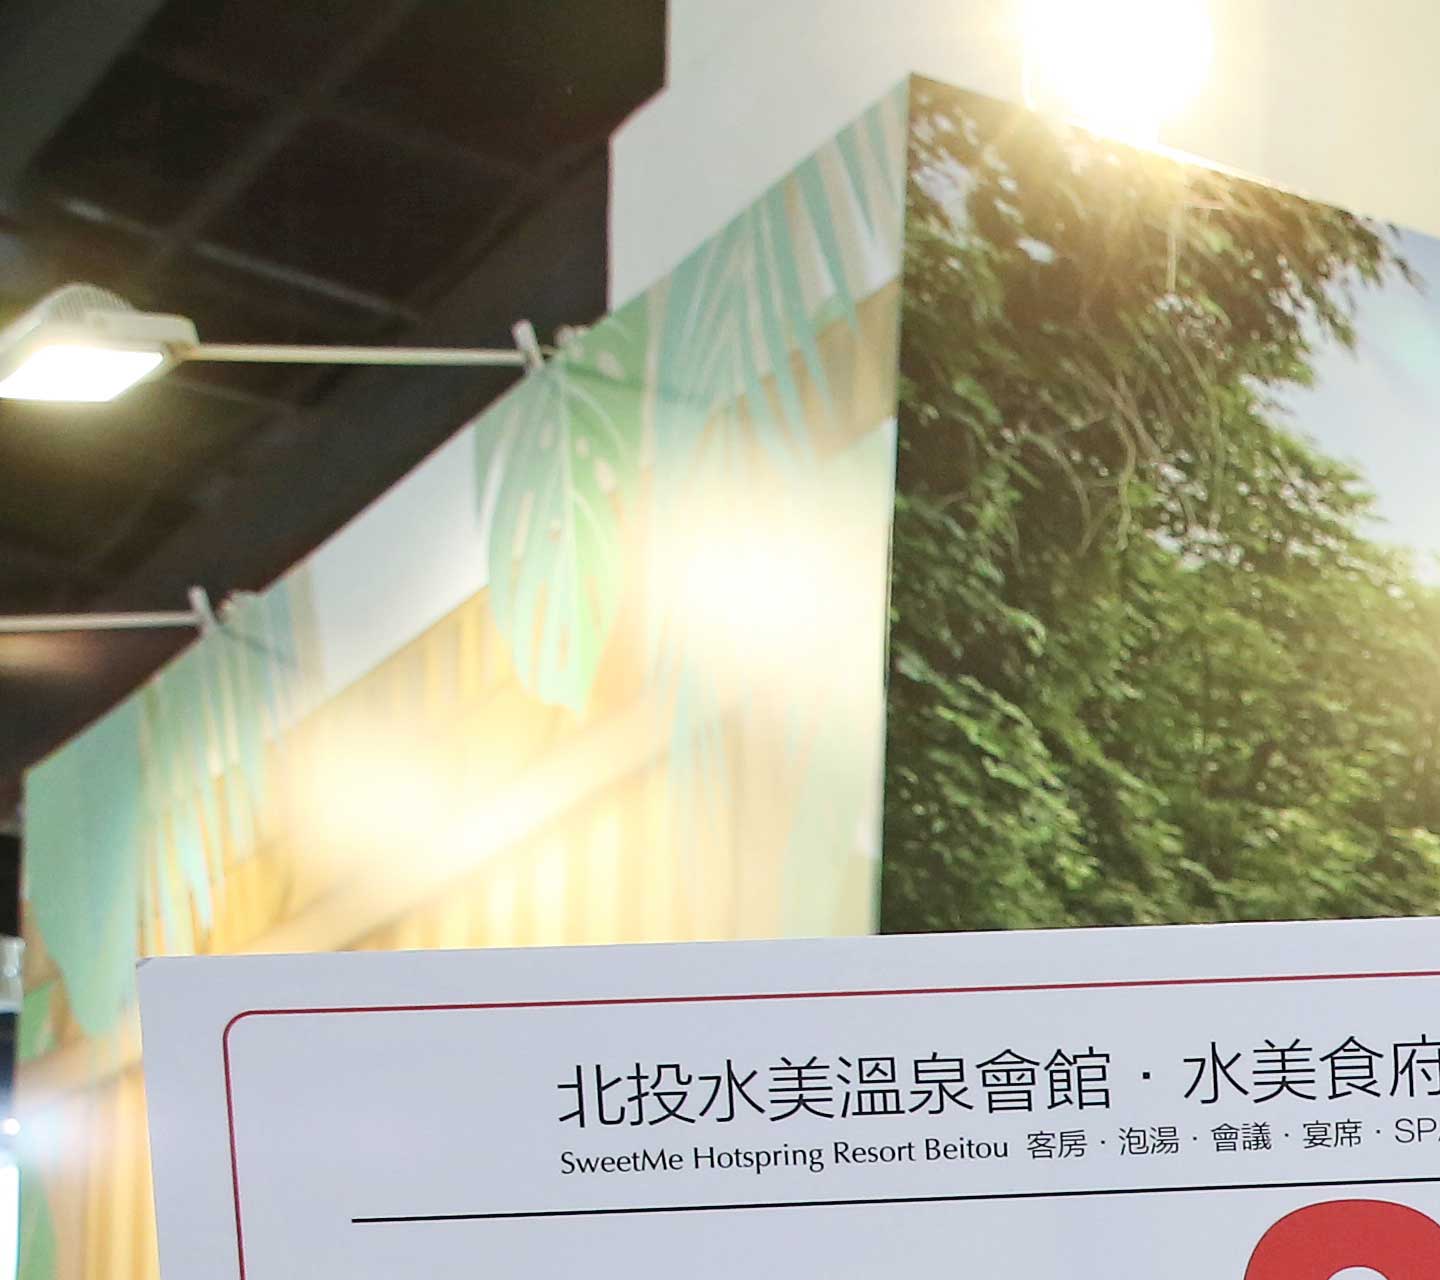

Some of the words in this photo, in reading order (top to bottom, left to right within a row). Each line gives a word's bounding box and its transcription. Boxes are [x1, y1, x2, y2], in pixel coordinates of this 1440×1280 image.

[560, 1144, 684, 1174] SweetMe
[693, 1138, 824, 1172] Hotspring
[834, 1137, 914, 1164] Resort
[924, 1134, 1010, 1162] Beitou
